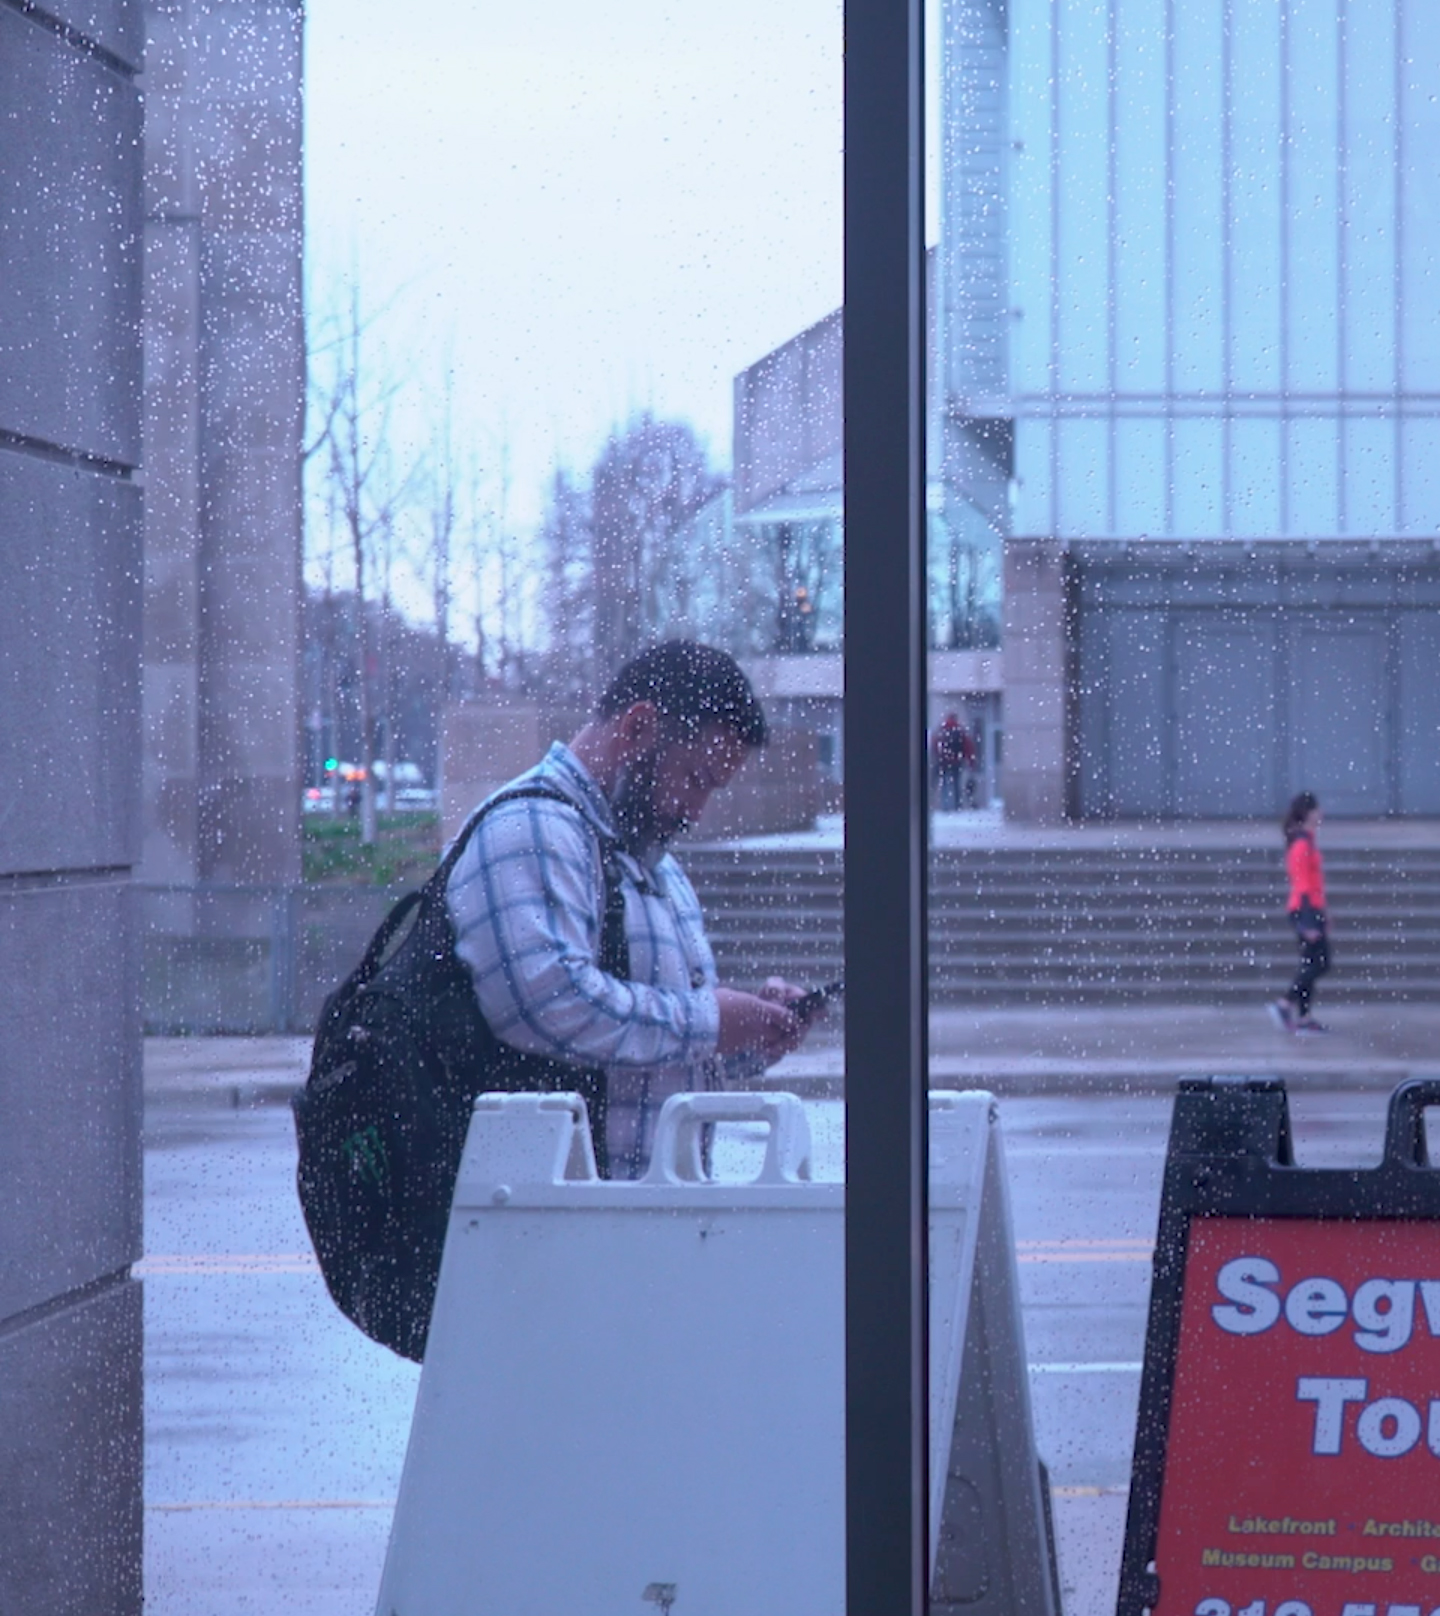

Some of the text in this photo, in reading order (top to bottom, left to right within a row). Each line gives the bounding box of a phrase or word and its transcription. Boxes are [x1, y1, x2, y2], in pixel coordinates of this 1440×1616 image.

[1228, 1514, 1337, 1536] Lakefront
[1201, 1548, 1296, 1570] Museum
[1301, 1551, 1395, 1574] Campus
